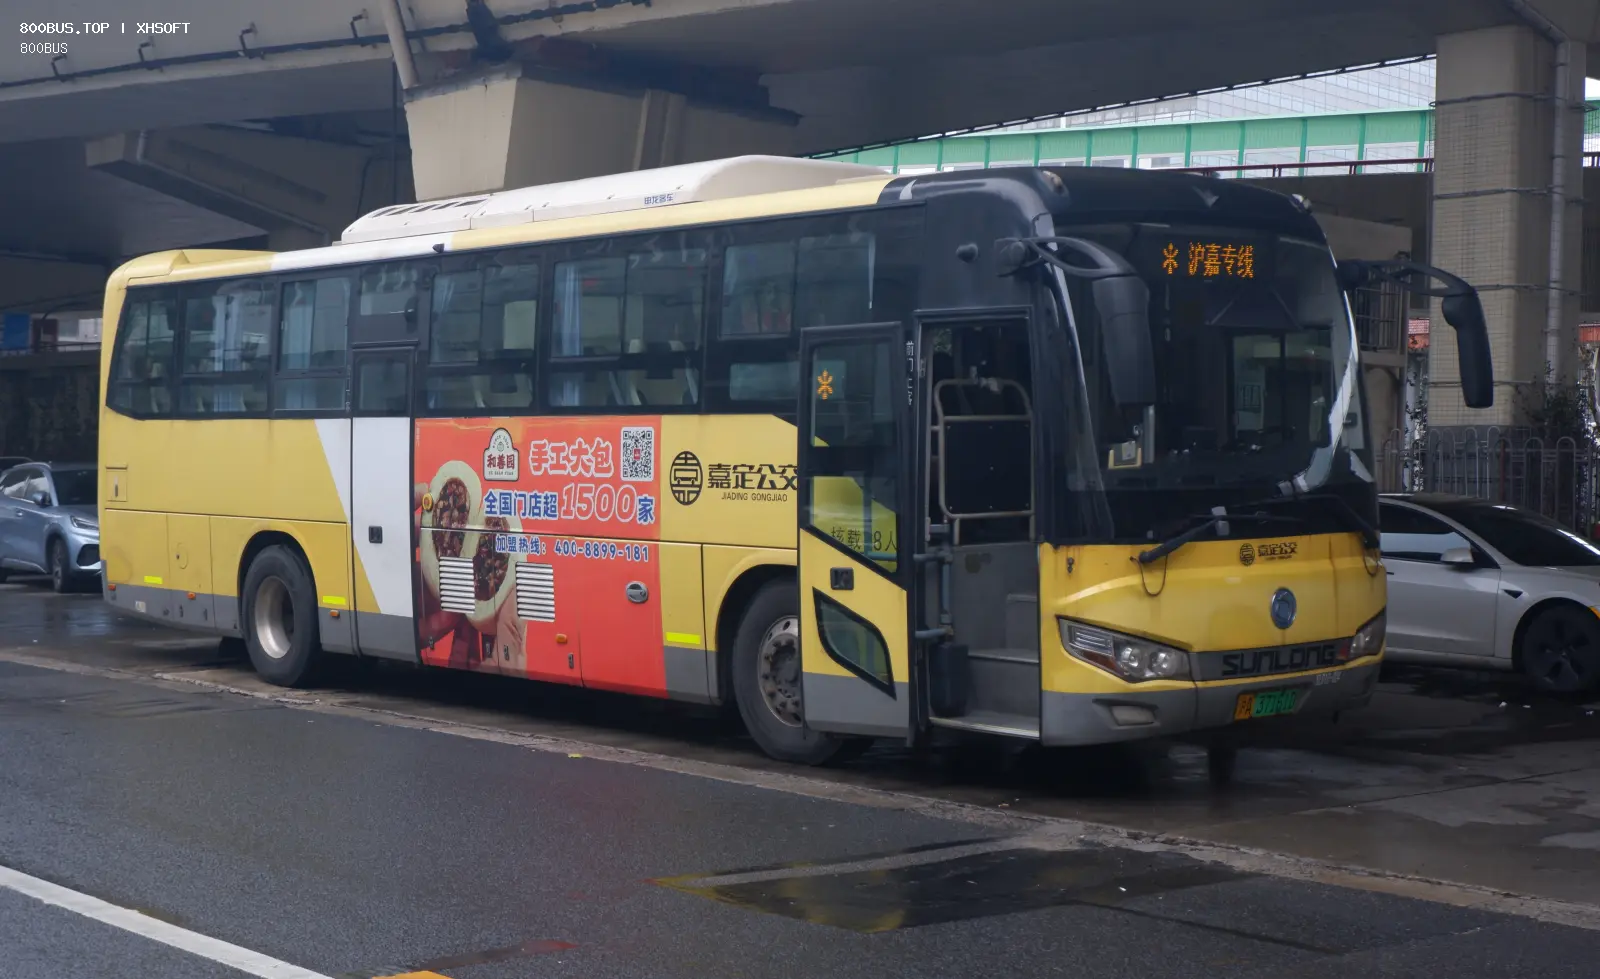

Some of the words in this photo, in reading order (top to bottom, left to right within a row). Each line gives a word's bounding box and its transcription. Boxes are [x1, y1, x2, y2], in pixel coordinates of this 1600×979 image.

[1188, 241, 1254, 278] 沪嘉专线
[487, 453, 515, 470] 和善园
[528, 437, 614, 477] 手工大包
[707, 463, 797, 490] 嘉定公交
[721, 491, 748, 501] JIADING
[751, 492, 788, 502] GONGJIAO
[554, 539, 649, 562] 400-8899-181
[830, 526, 897, 551] 核载8人
[1222, 645, 1335, 676] SUNLONG
